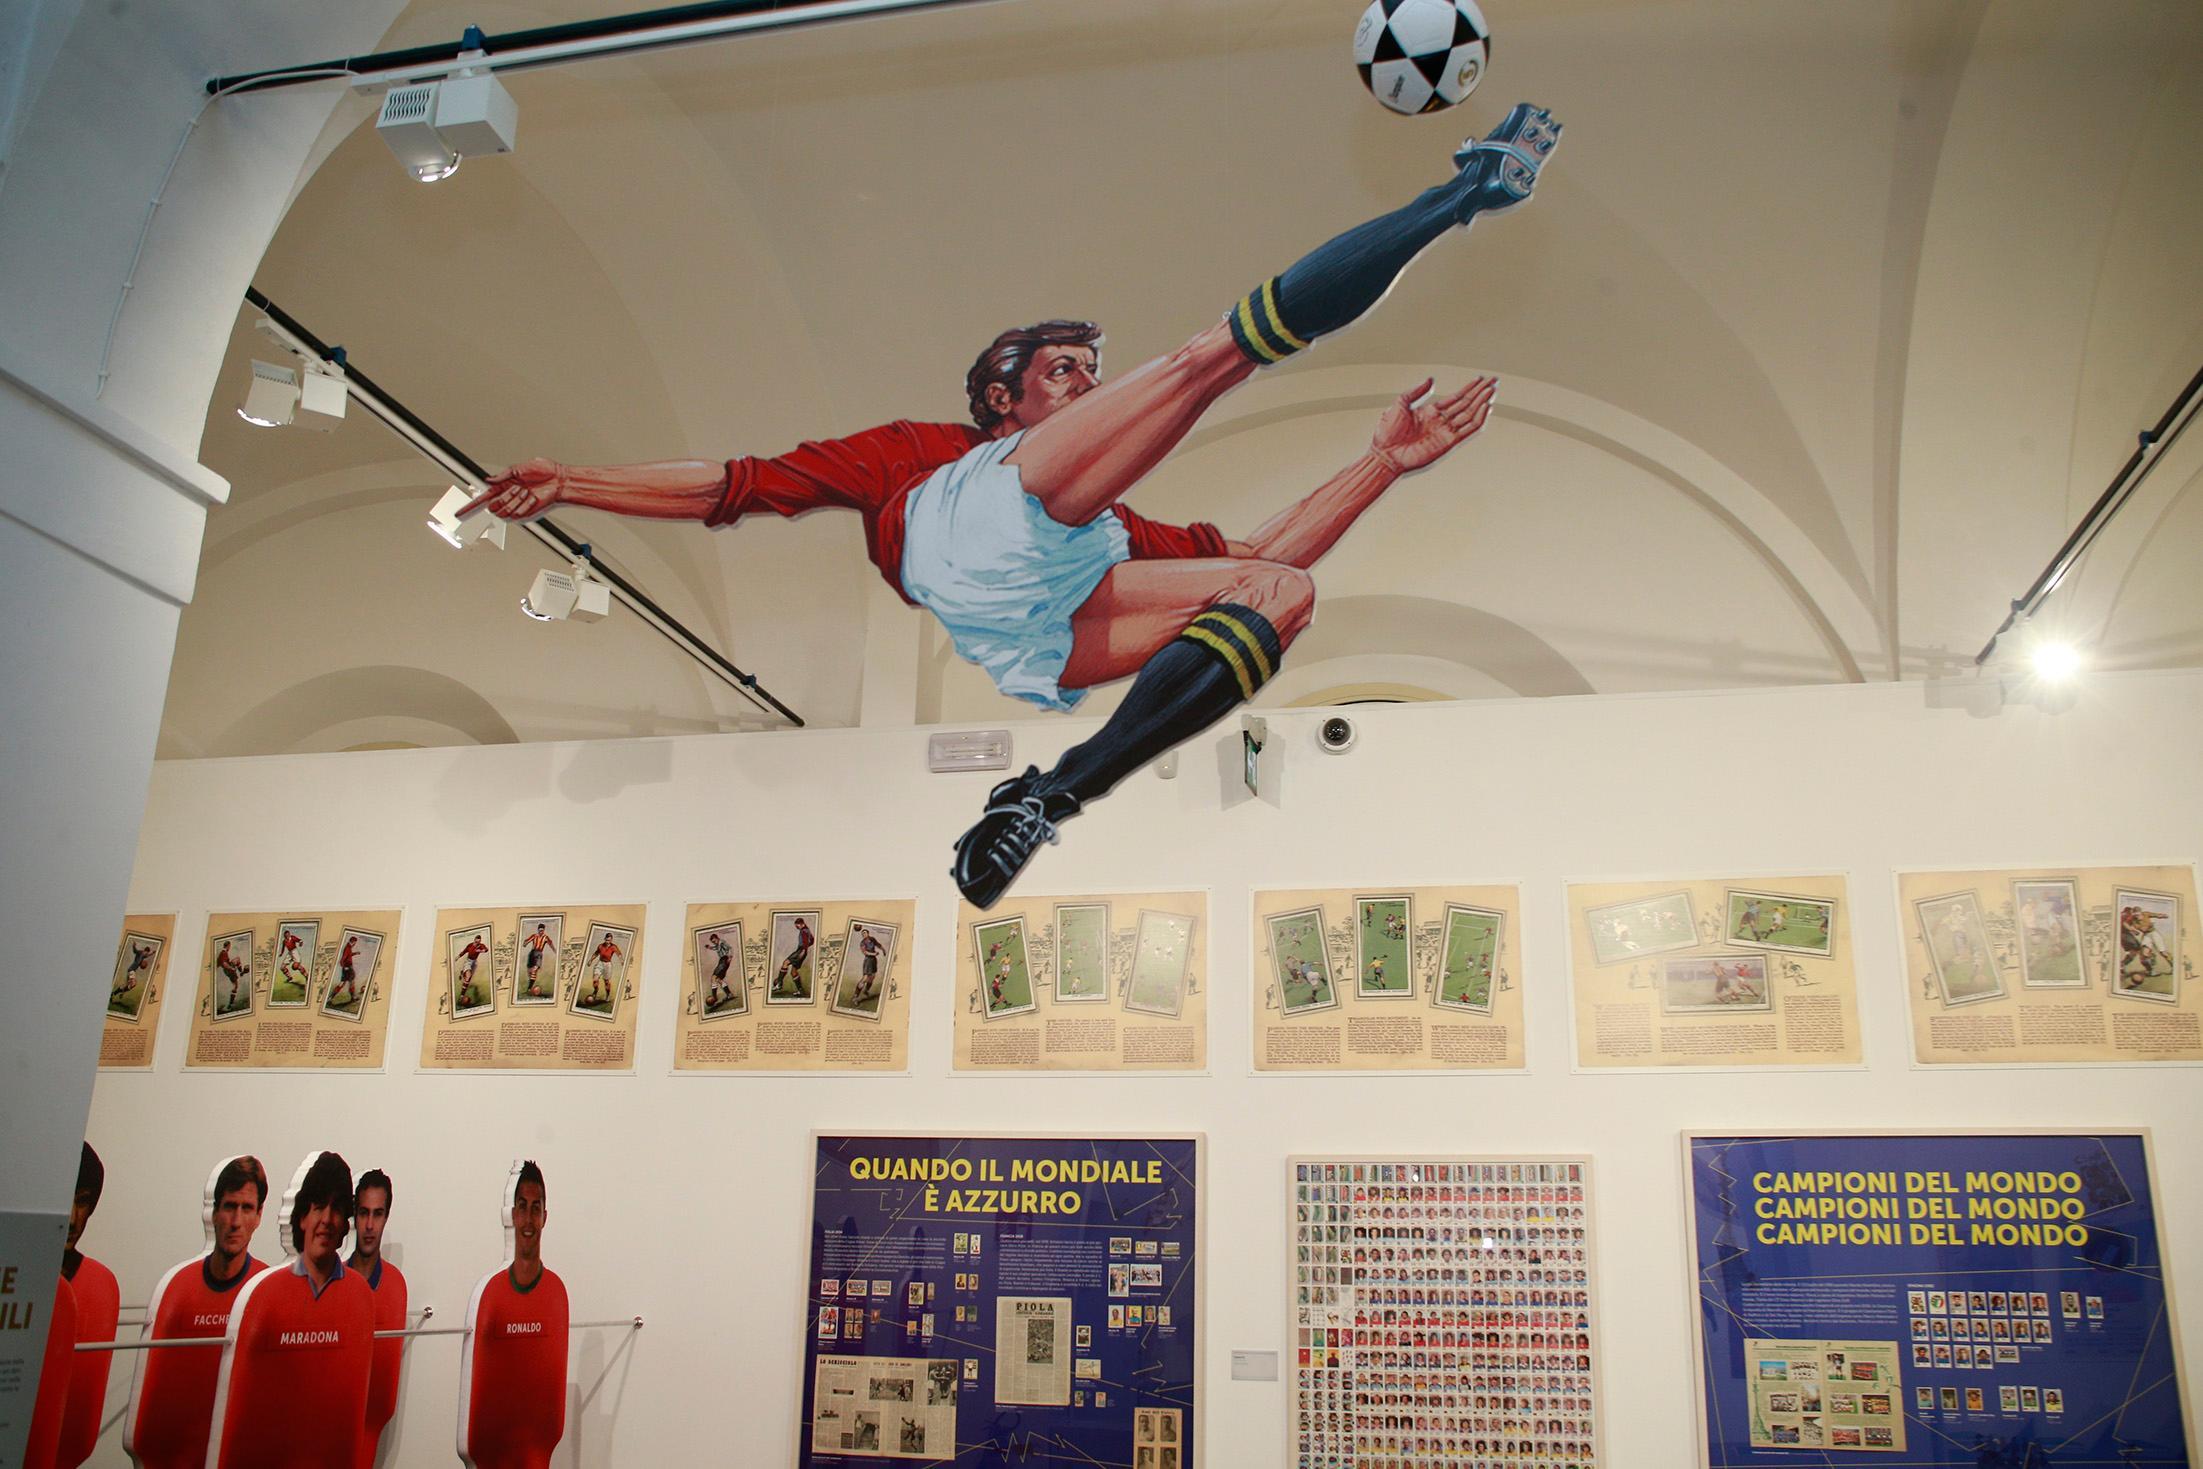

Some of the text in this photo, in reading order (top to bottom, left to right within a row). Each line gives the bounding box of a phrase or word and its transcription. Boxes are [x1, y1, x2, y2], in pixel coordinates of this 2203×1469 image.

[850, 1158, 1162, 1184] QUANDO IL MONDIALE
[1753, 1172, 2082, 1194] CAMPIONI DEL MONDO
[925, 1184, 1081, 1214] È AZZURRO
[1755, 1197, 2085, 1220] CAMPIONI DEL MONDO
[1757, 1223, 2088, 1246] CAMPIONI DEL MONDO
[1016, 1302, 1054, 1311] PIOLA
[280, 1331, 339, 1345] MARADONA
[506, 1323, 542, 1333] RONALDO
